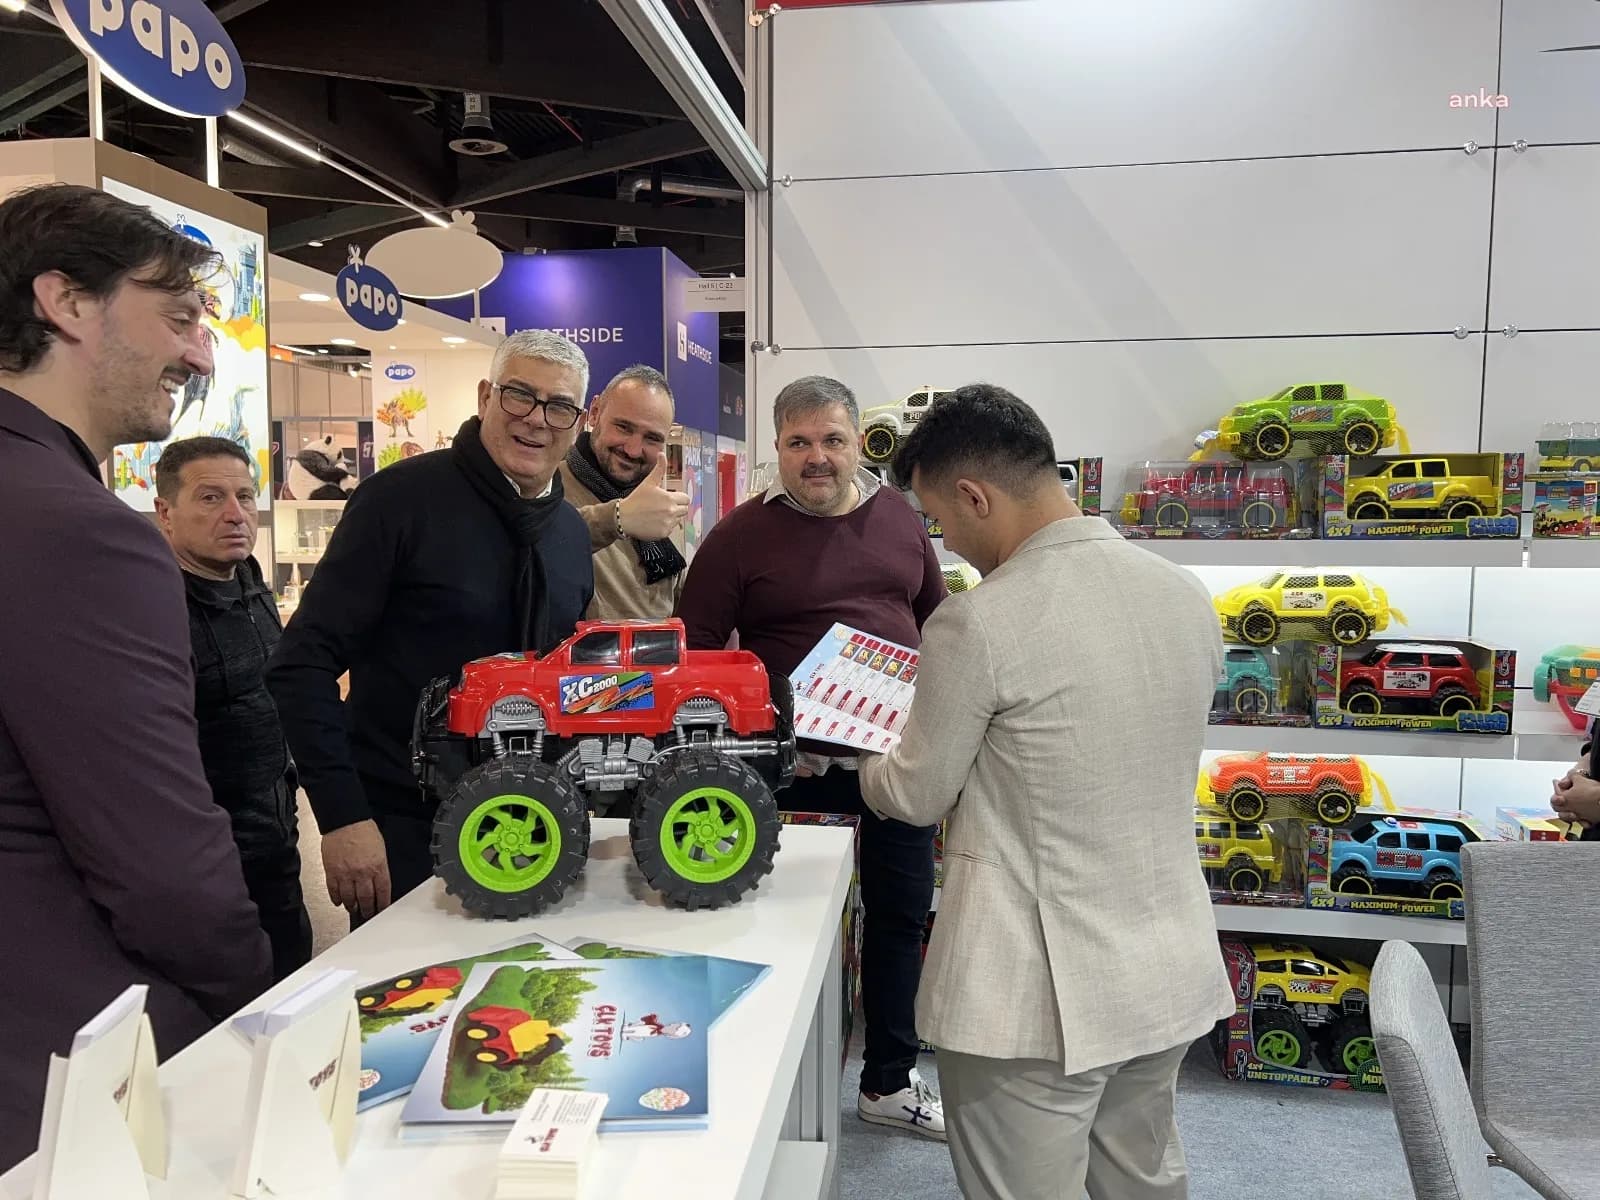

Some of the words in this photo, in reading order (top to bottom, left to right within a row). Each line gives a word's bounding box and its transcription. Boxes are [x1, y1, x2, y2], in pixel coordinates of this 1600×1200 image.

[90, 0, 232, 89] papo
[346, 279, 397, 316] papo
[388, 368, 414, 377] papo
[1367, 526, 1415, 536] MAXIMUM
[1419, 525, 1453, 534] POWER
[563, 676, 618, 705] XC2000
[1354, 719, 1398, 727] MAXIMUM
[1400, 719, 1432, 728] POWER
[1351, 901, 1398, 910] MAXIMUM
[1402, 904, 1435, 913] POWER
[588, 1027, 613, 1057] TOYS
[1247, 1071, 1320, 1085] UNSTOPPABLE
